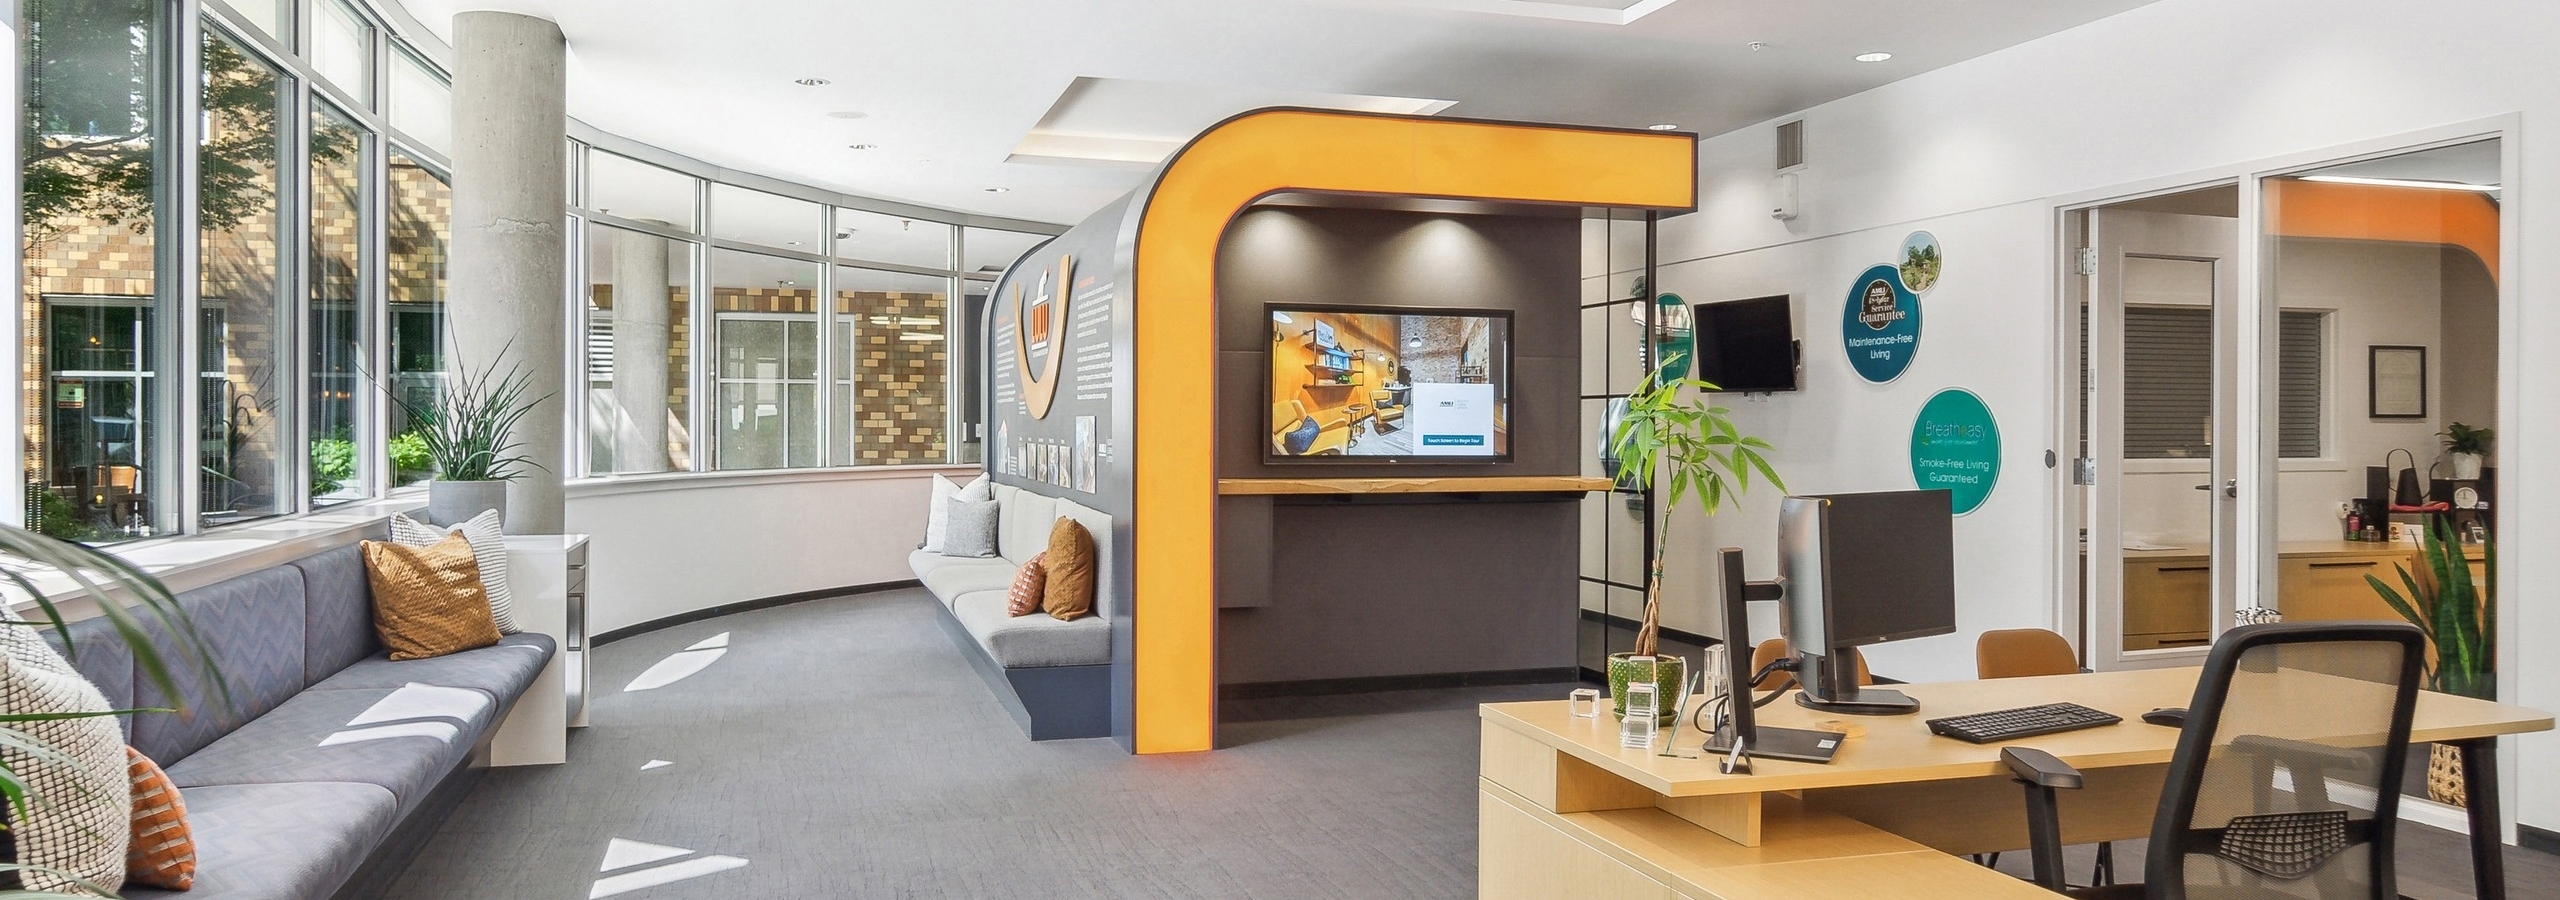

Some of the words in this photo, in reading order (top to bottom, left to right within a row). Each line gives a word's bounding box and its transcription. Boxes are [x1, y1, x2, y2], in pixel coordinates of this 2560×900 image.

[1871, 287, 1886, 295] AMLI
[1871, 303, 1893, 312] Service
[1858, 310, 1906, 323] Guarantee
[1848, 334, 1914, 347] Maintenance-Free
[1870, 350, 1891, 360] Living
[1925, 420, 1986, 441] Breatheasy
[1919, 457, 1965, 469] Smoke-Free
[1966, 459, 1990, 472] Living
[1929, 472, 1979, 484] Guaranteed
